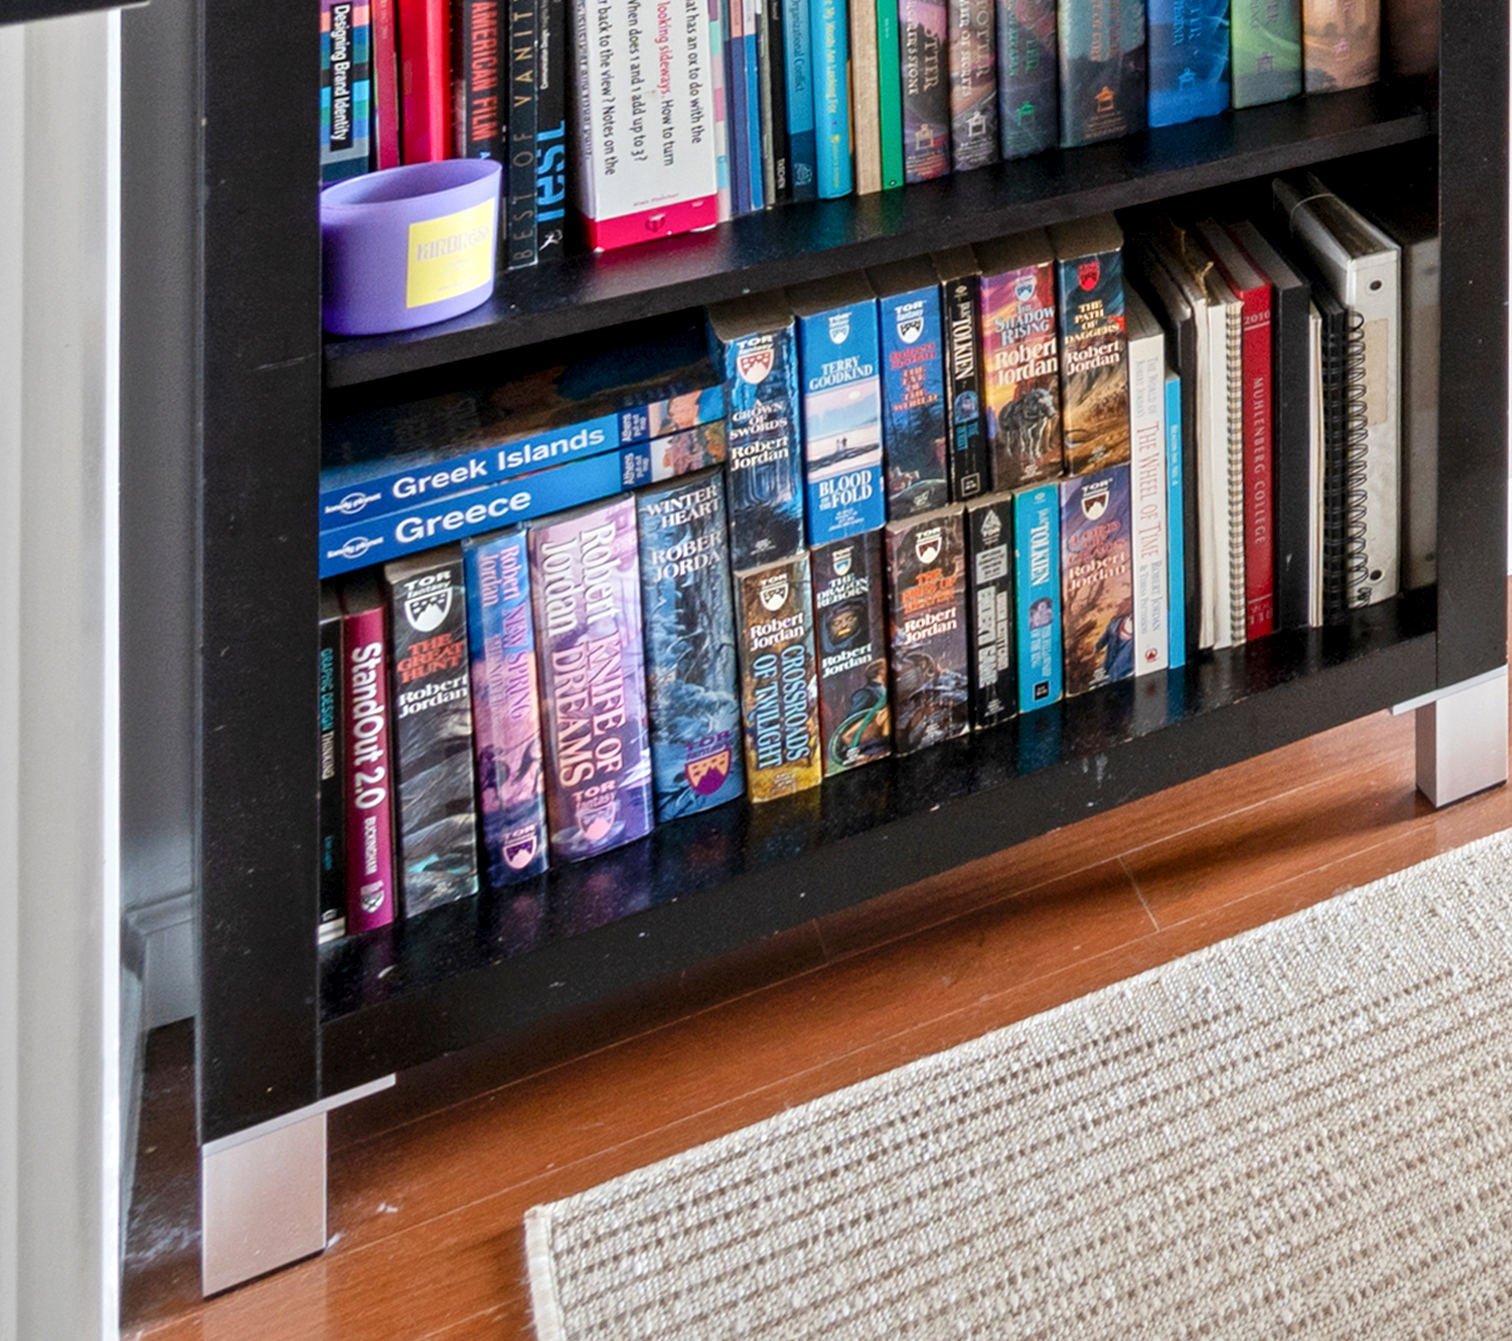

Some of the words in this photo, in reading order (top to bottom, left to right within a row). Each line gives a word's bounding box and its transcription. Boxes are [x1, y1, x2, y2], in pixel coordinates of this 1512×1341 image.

[331, 3, 351, 62] Designing
[655, 2, 672, 44] looking
[687, 13, 700, 34] has
[471, 0, 498, 93] AMERICAN
[688, 36, 698, 51] an
[657, 45, 673, 98] sideways.
[688, 52, 698, 66] ox
[331, 63, 349, 98] Brand
[689, 67, 701, 80] to
[690, 82, 703, 96] do
[330, 98, 349, 142] Identity
[472, 96, 498, 142] FILM
[661, 99, 674, 124] How
[690, 97, 704, 123] with
[662, 127, 675, 139] to
[691, 125, 705, 144] the
[514, 132, 533, 167] OF
[663, 141, 675, 166] turn
[513, 194, 534, 262] BEST
[895, 299, 927, 314] TOR
[994, 306, 1056, 333] SHADOW
[1243, 310, 1271, 326] 2010
[736, 334, 773, 348] TOR
[1001, 318, 1051, 347] RISING
[1064, 323, 1120, 345] DAGGERS
[952, 320, 975, 381] TOLKIEN
[994, 336, 1058, 371] Robert
[1066, 353, 1121, 376] Jordan
[1067, 340, 1120, 364] Robert
[809, 364, 873, 390] GOODKIND
[821, 355, 860, 375] TERRY
[997, 355, 1058, 386] Jordan
[729, 419, 788, 441] SWORDS
[1137, 420, 1160, 444] THE
[1252, 377, 1266, 475] MUHLENBERG
[730, 449, 790, 472] Jordan
[731, 435, 789, 459] Robert
[391, 458, 488, 499] Greek
[497, 427, 606, 471] Islands
[1138, 448, 1159, 503] WHEEL
[819, 470, 873, 498] BLOOD
[831, 483, 873, 509] FOLD
[394, 491, 532, 544] Greece
[661, 498, 720, 529] HEART
[1141, 504, 1159, 521] OF
[1253, 479, 1266, 545] COLLEGE
[1138, 521, 1160, 559] TIME
[1030, 523, 1050, 587] TOLKIEN
[1068, 551, 1126, 579] Robert
[404, 570, 451, 591] TOR
[481, 554, 498, 608] Jordan
[502, 545, 519, 602] Robert
[581, 522, 621, 624] Robert
[761, 573, 788, 586] TOR
[1068, 564, 1127, 592] Jordan
[541, 541, 579, 638] Jordan
[750, 612, 804, 638] Robert
[903, 607, 956, 633] Robert
[904, 619, 958, 645] Jordan
[750, 625, 805, 652] Jordan
[753, 653, 778, 679] OF
[822, 643, 873, 668] Robert
[822, 654, 873, 679] Jordan
[398, 675, 468, 705] Robert
[589, 631, 627, 734] KNIFE
[351, 641, 385, 766] StandOut
[398, 688, 468, 719] Jordan
[552, 641, 596, 789] DREAMS
[781, 644, 810, 761] CROSSROADS
[755, 683, 783, 768] TWILIGHT
[594, 737, 624, 774] OF
[354, 767, 387, 810] 2.0
